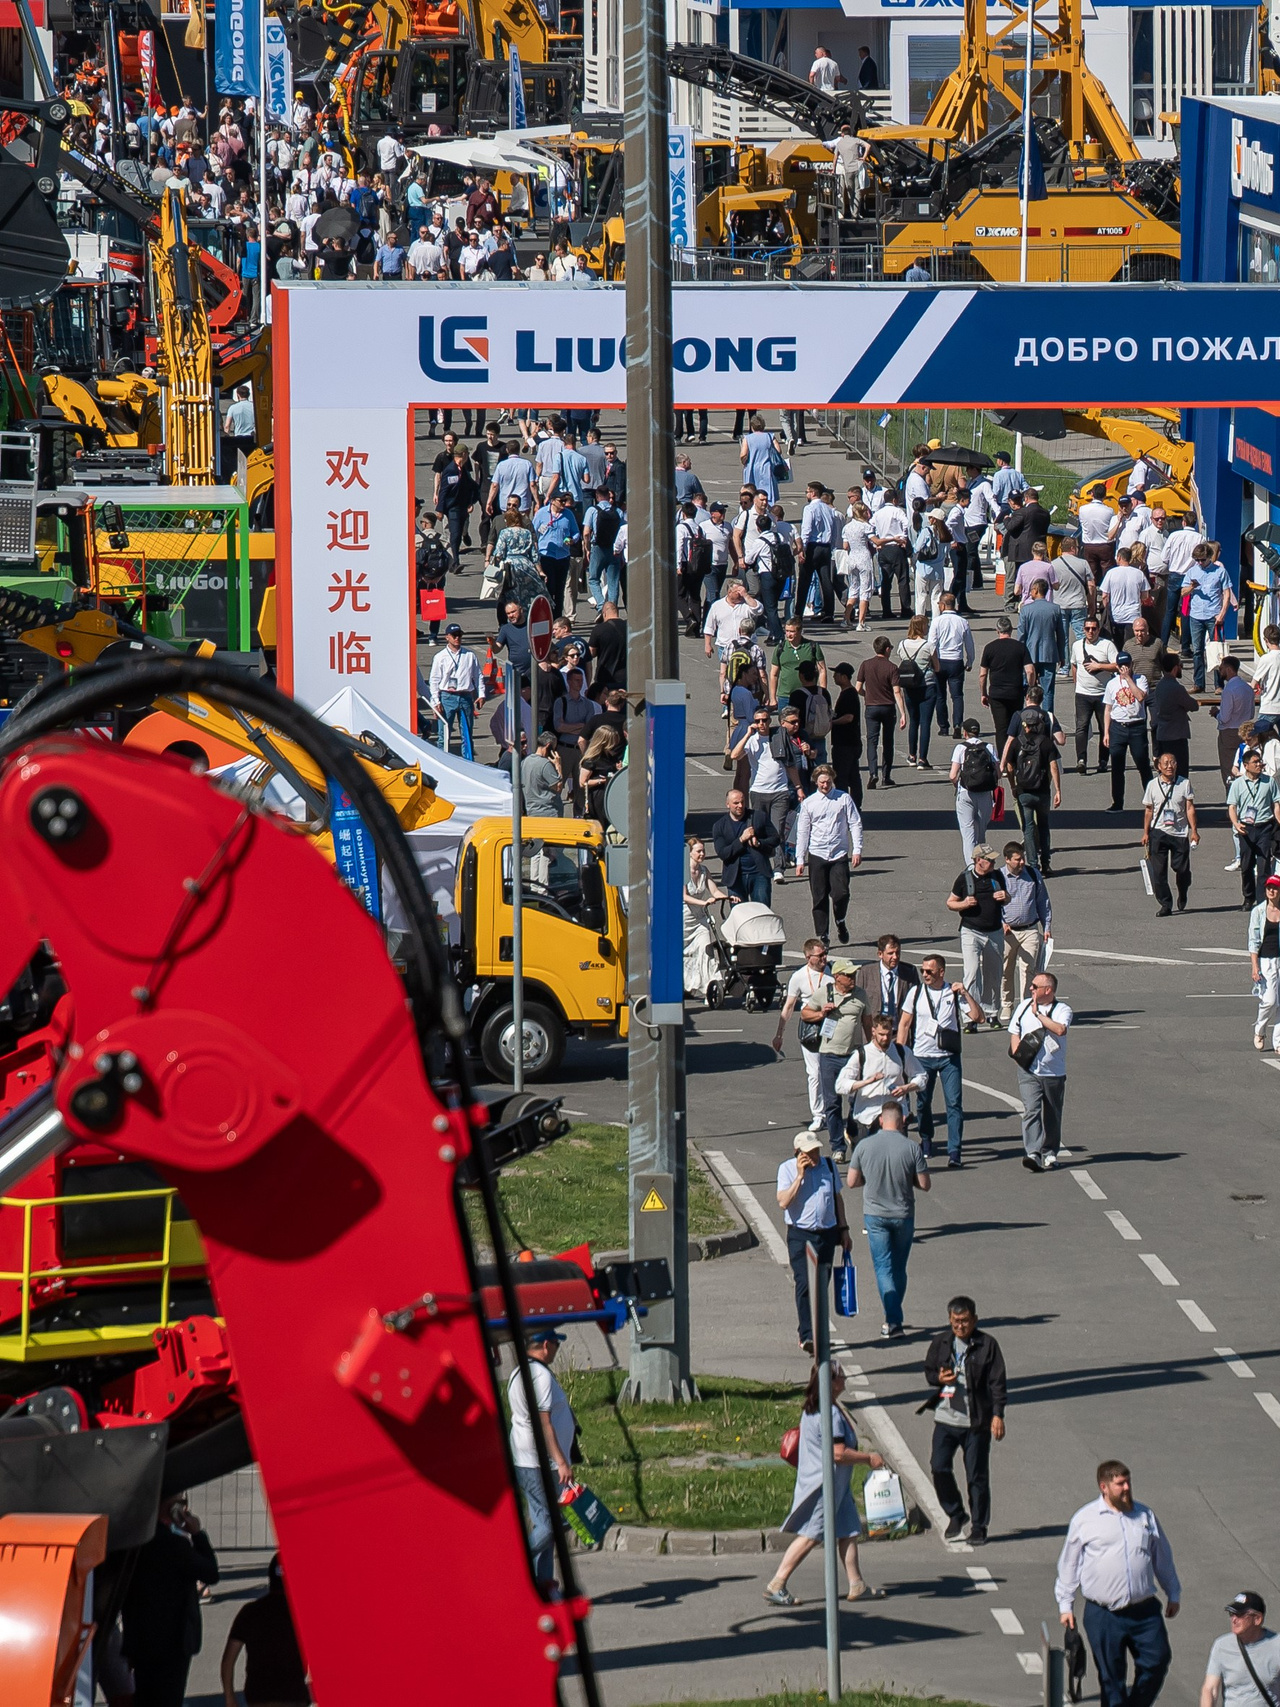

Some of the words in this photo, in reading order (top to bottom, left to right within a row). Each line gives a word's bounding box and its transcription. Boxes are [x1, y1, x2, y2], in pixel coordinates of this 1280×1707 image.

[268, 49, 287, 115] XCMG
[670, 166, 689, 249] XCMG
[985, 227, 1019, 237] XCMG
[1097, 227, 1124, 236] AT1005
[516, 330, 797, 373] LIUONG
[1014, 337, 1138, 367] ДОБРО
[326, 446, 371, 675] 欢迎光临
